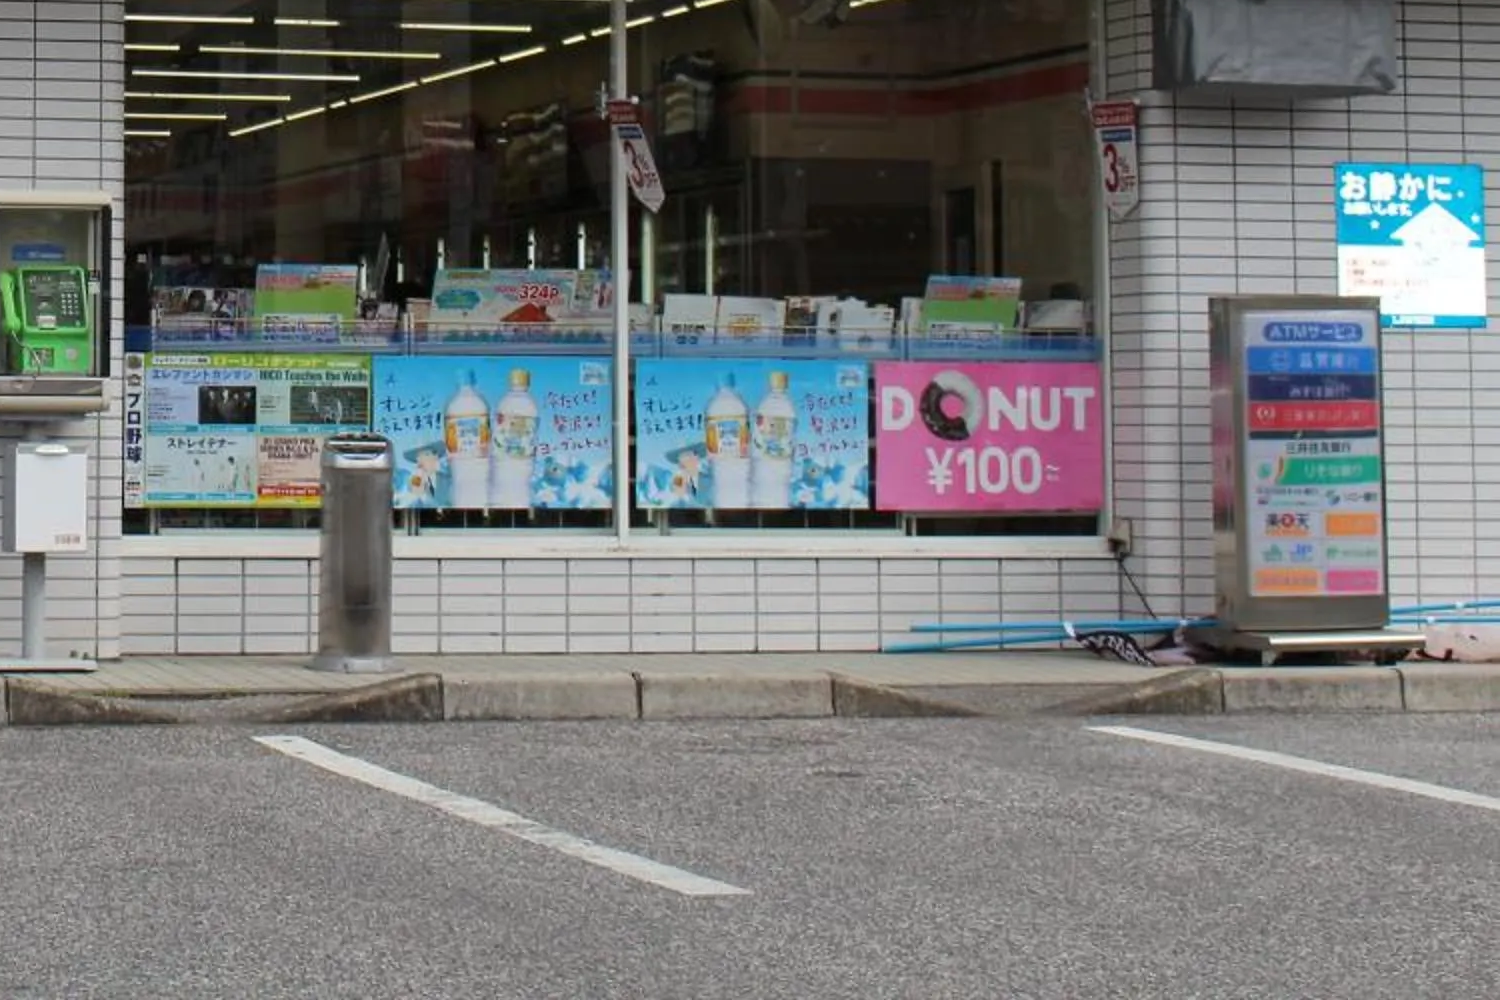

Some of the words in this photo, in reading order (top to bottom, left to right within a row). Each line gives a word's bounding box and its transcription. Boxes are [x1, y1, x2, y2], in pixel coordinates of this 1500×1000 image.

[1268, 324, 1359, 341] ATMサービス
[881, 370, 1095, 441] DONUT
[127, 393, 143, 464] プロ野球
[166, 438, 238, 450] ストレイテナー
